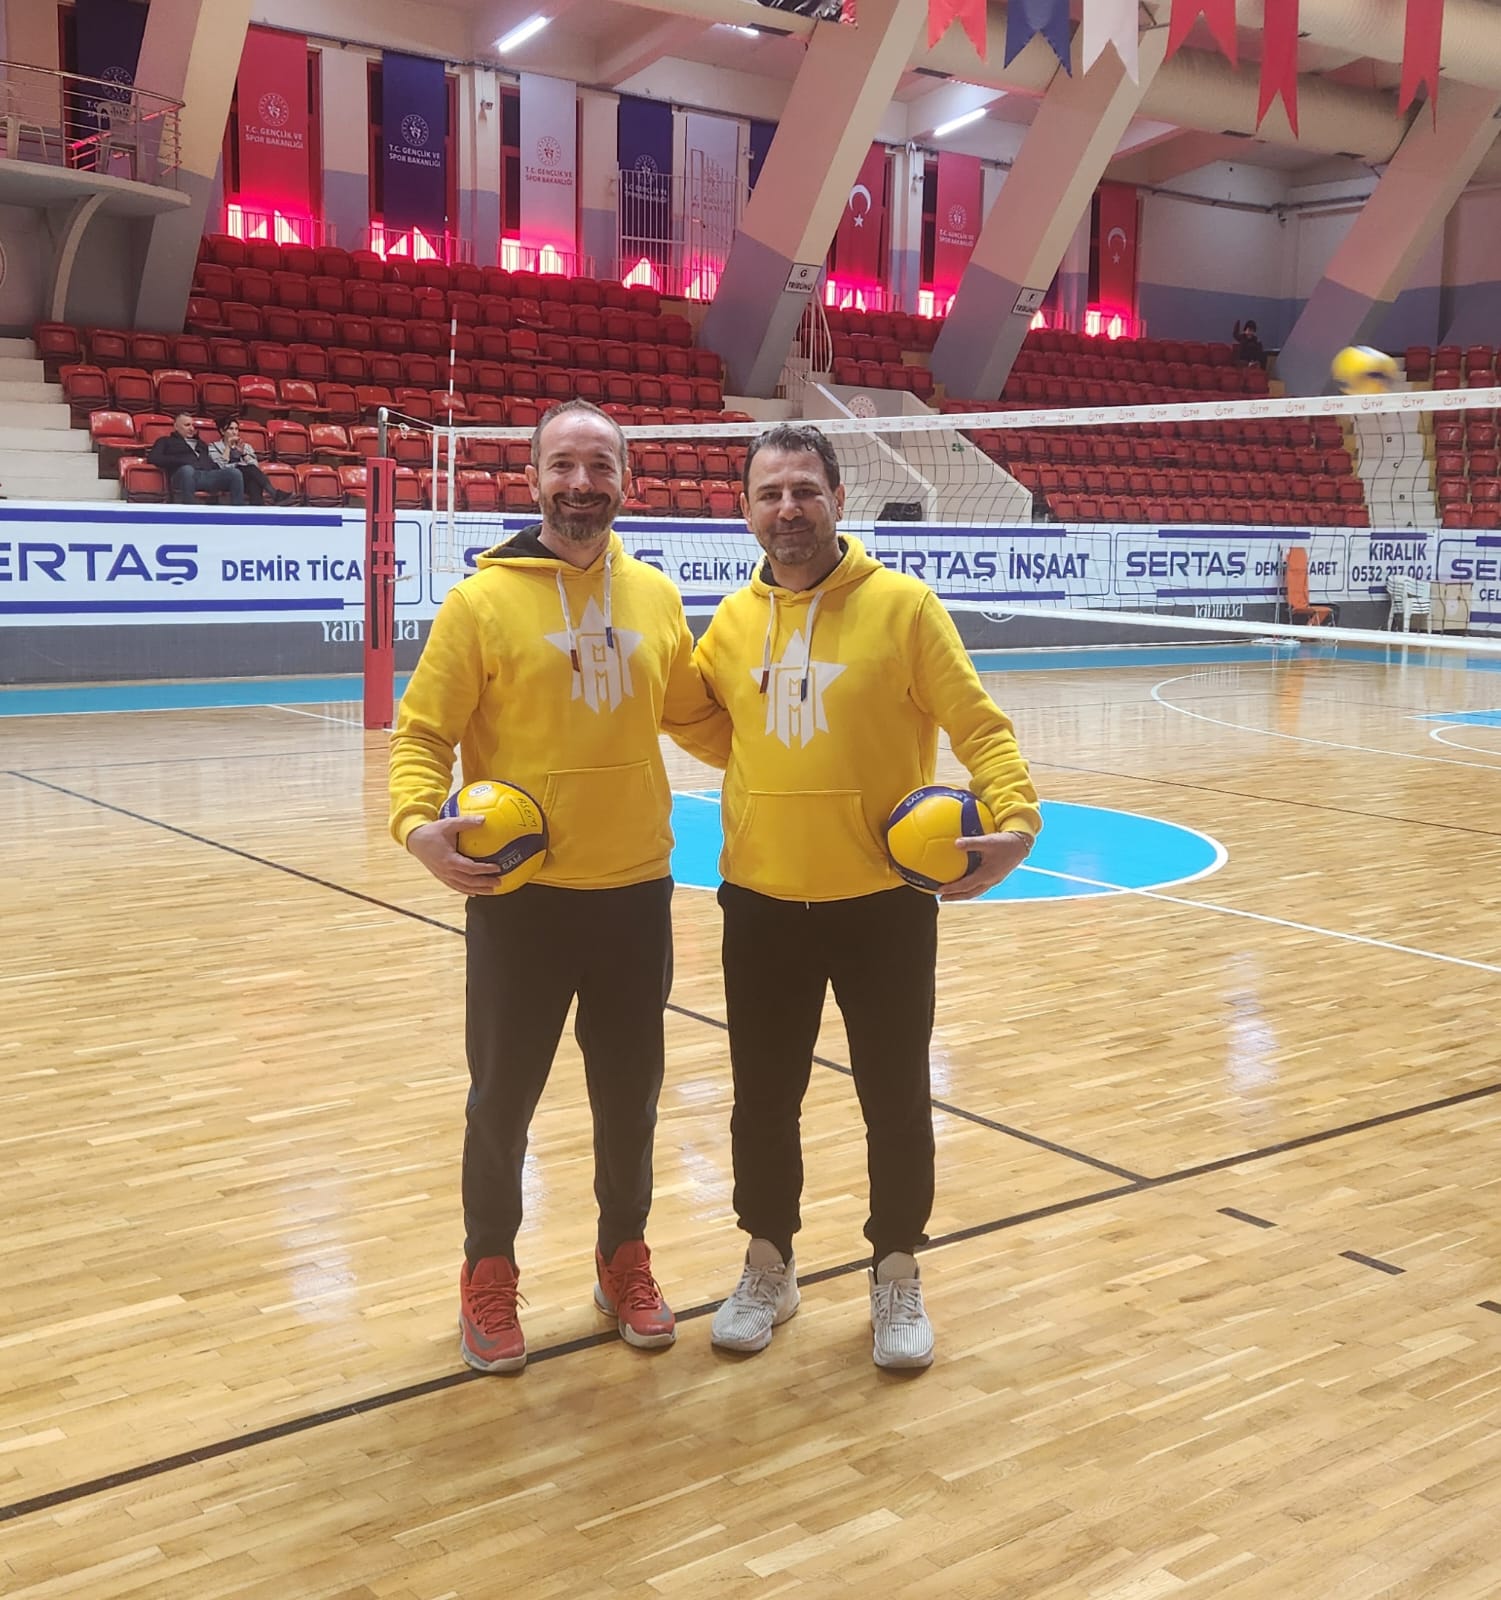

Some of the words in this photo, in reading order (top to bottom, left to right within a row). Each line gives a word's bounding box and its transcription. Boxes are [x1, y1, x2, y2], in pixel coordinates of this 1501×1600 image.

[245, 134, 264, 143] SPOR
[389, 152, 406, 161] SPOR
[800, 269, 808, 278] G
[221, 555, 300, 581] DEMİR
[306, 555, 406, 581] TİCAT
[679, 557, 731, 582] ÇELİK
[866, 551, 997, 582] ERTAŞ
[1009, 547, 1090, 584] İNŞAAT
[1126, 551, 1247, 578] SERTAŞ
[1307, 561, 1338, 576] ARET
[1352, 565, 1383, 582] 0532
[1451, 559, 1501, 580] SE
